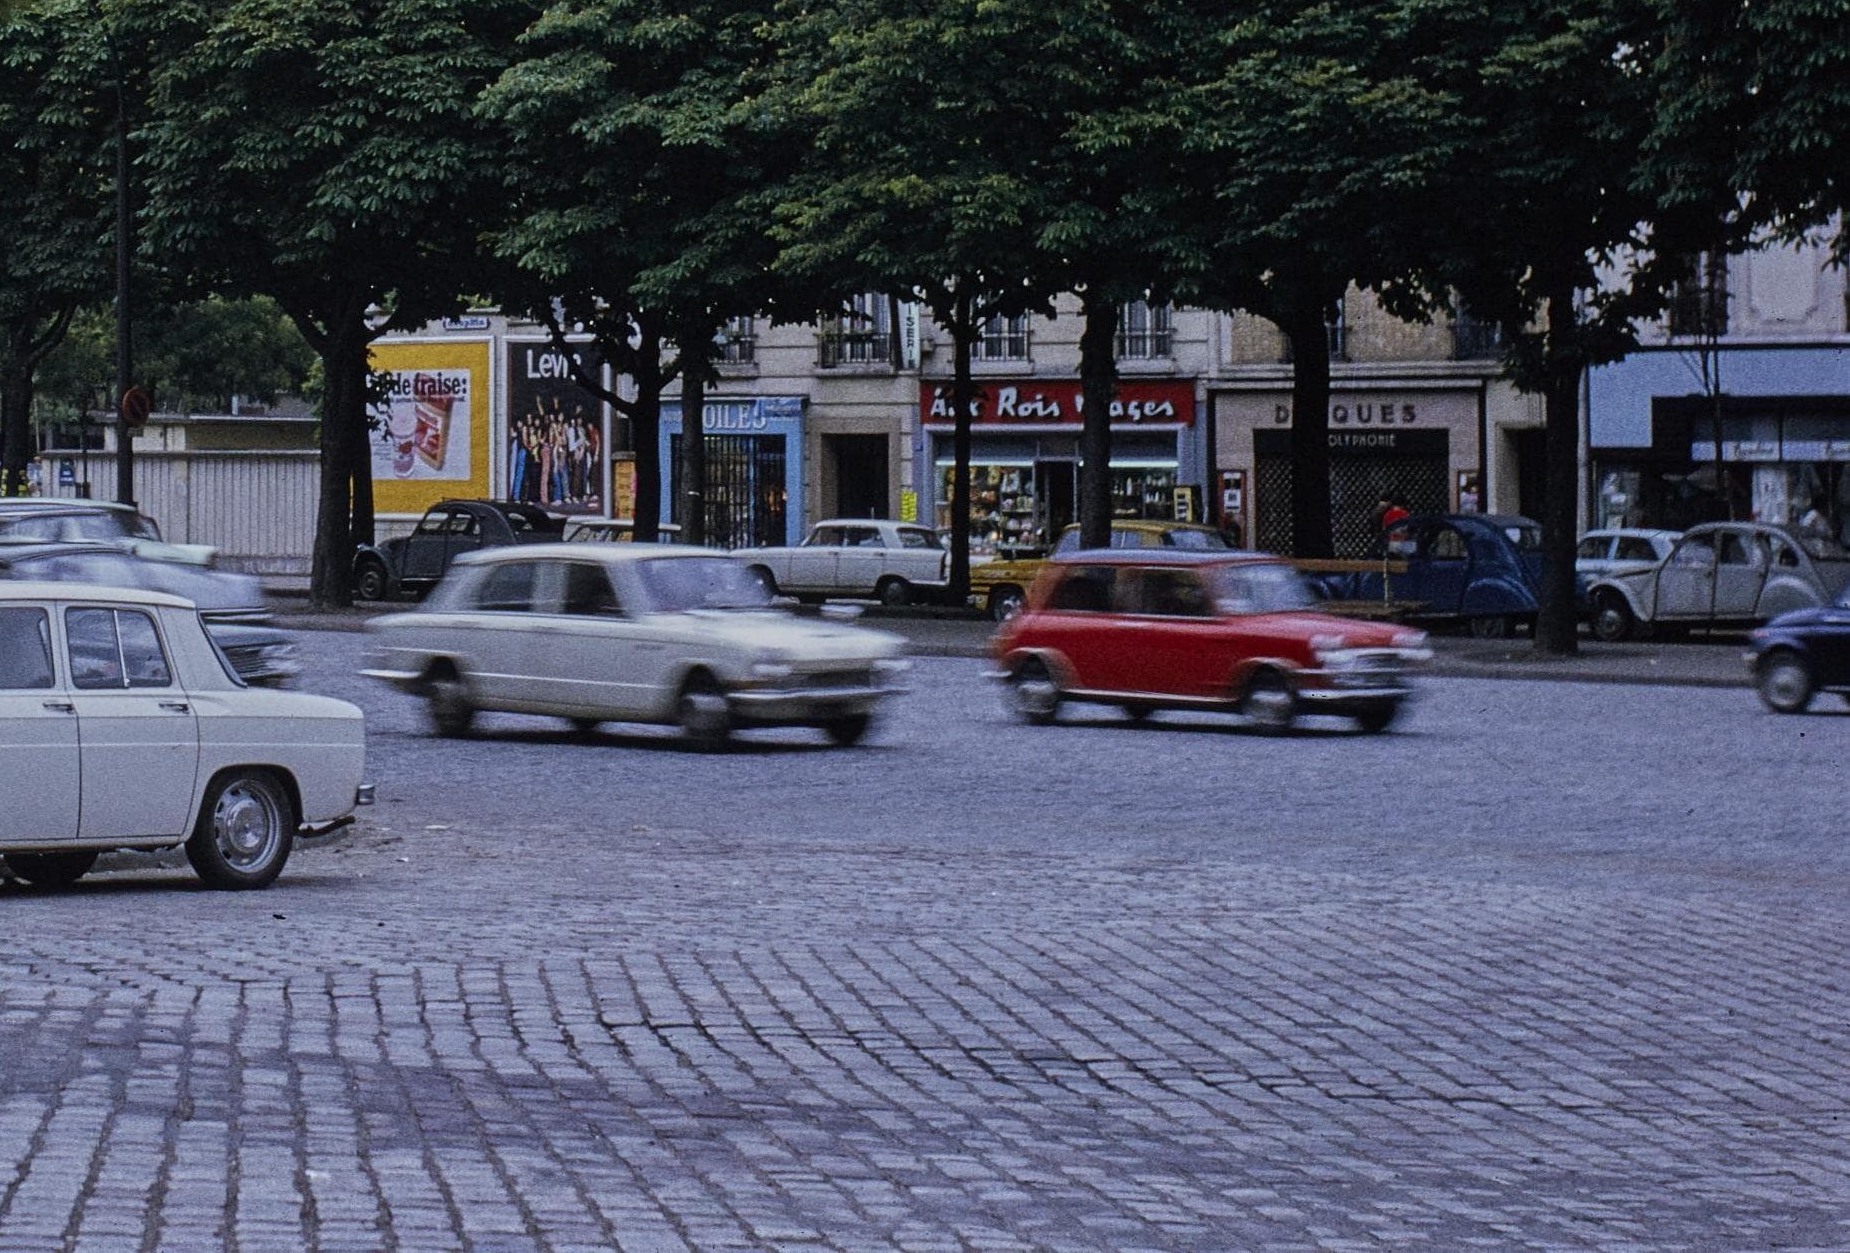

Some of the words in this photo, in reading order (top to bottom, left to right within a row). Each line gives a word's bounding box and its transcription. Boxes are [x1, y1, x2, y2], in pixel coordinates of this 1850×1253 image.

[390, 373, 410, 396] de
[412, 372, 468, 396] fraise:
[998, 386, 1060, 418] Rois
[1274, 402, 1416, 424] DQUES
[1327, 433, 1396, 447] OLYPHONIE
